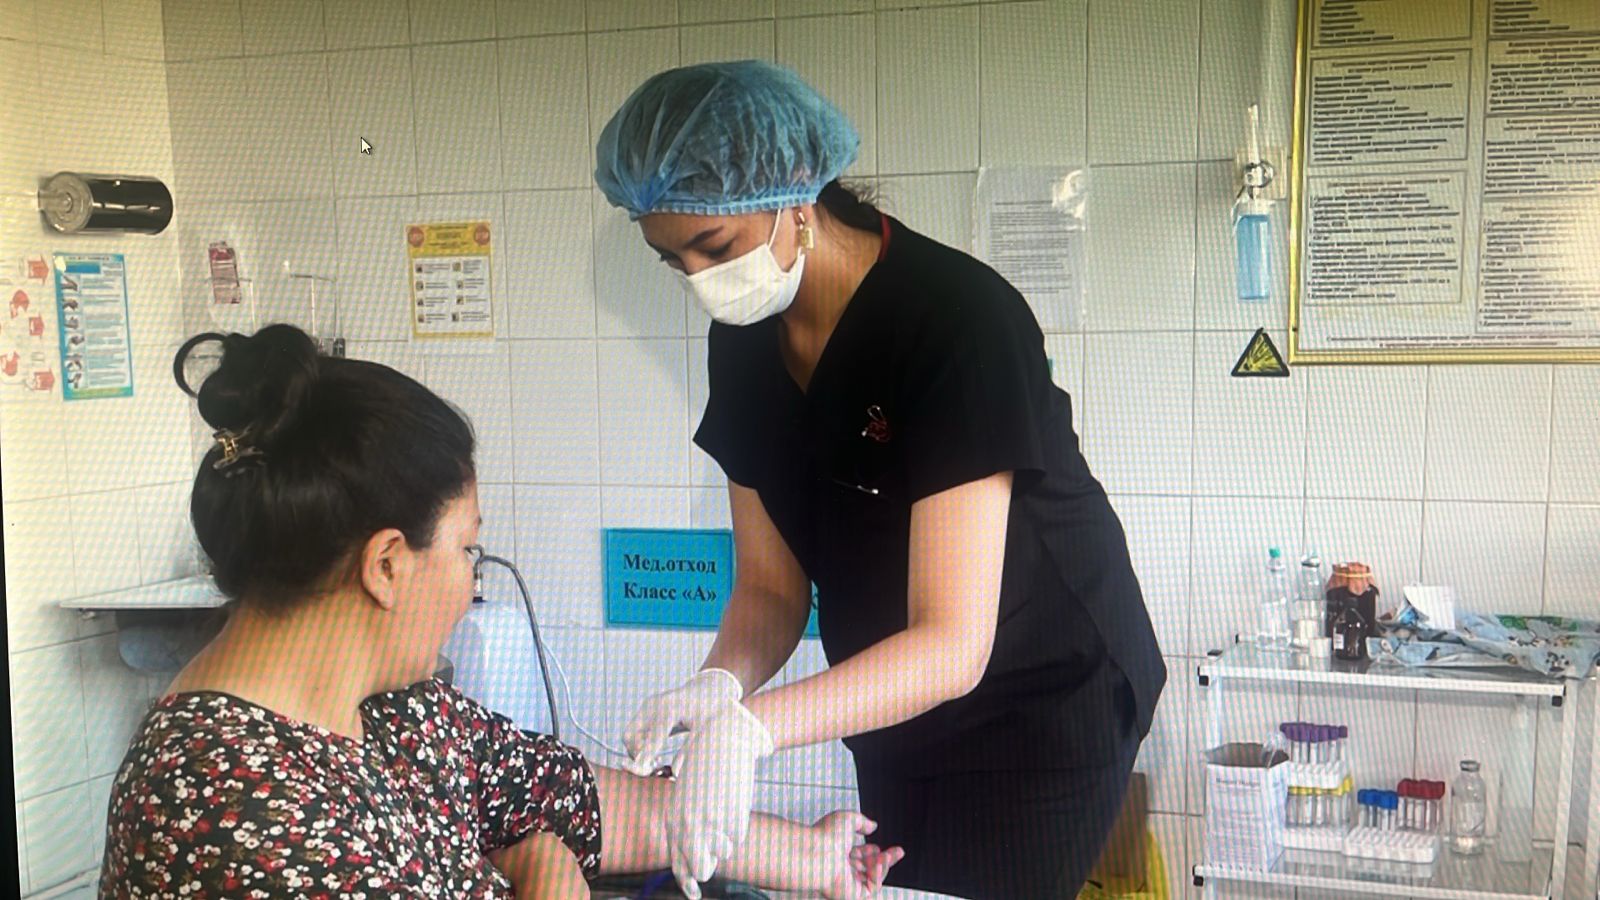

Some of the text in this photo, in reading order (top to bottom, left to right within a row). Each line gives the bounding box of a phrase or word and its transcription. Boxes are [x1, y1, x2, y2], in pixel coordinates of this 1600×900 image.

[624, 554, 717, 575] Мед.отход
[624, 582, 717, 601] Класс «А»
